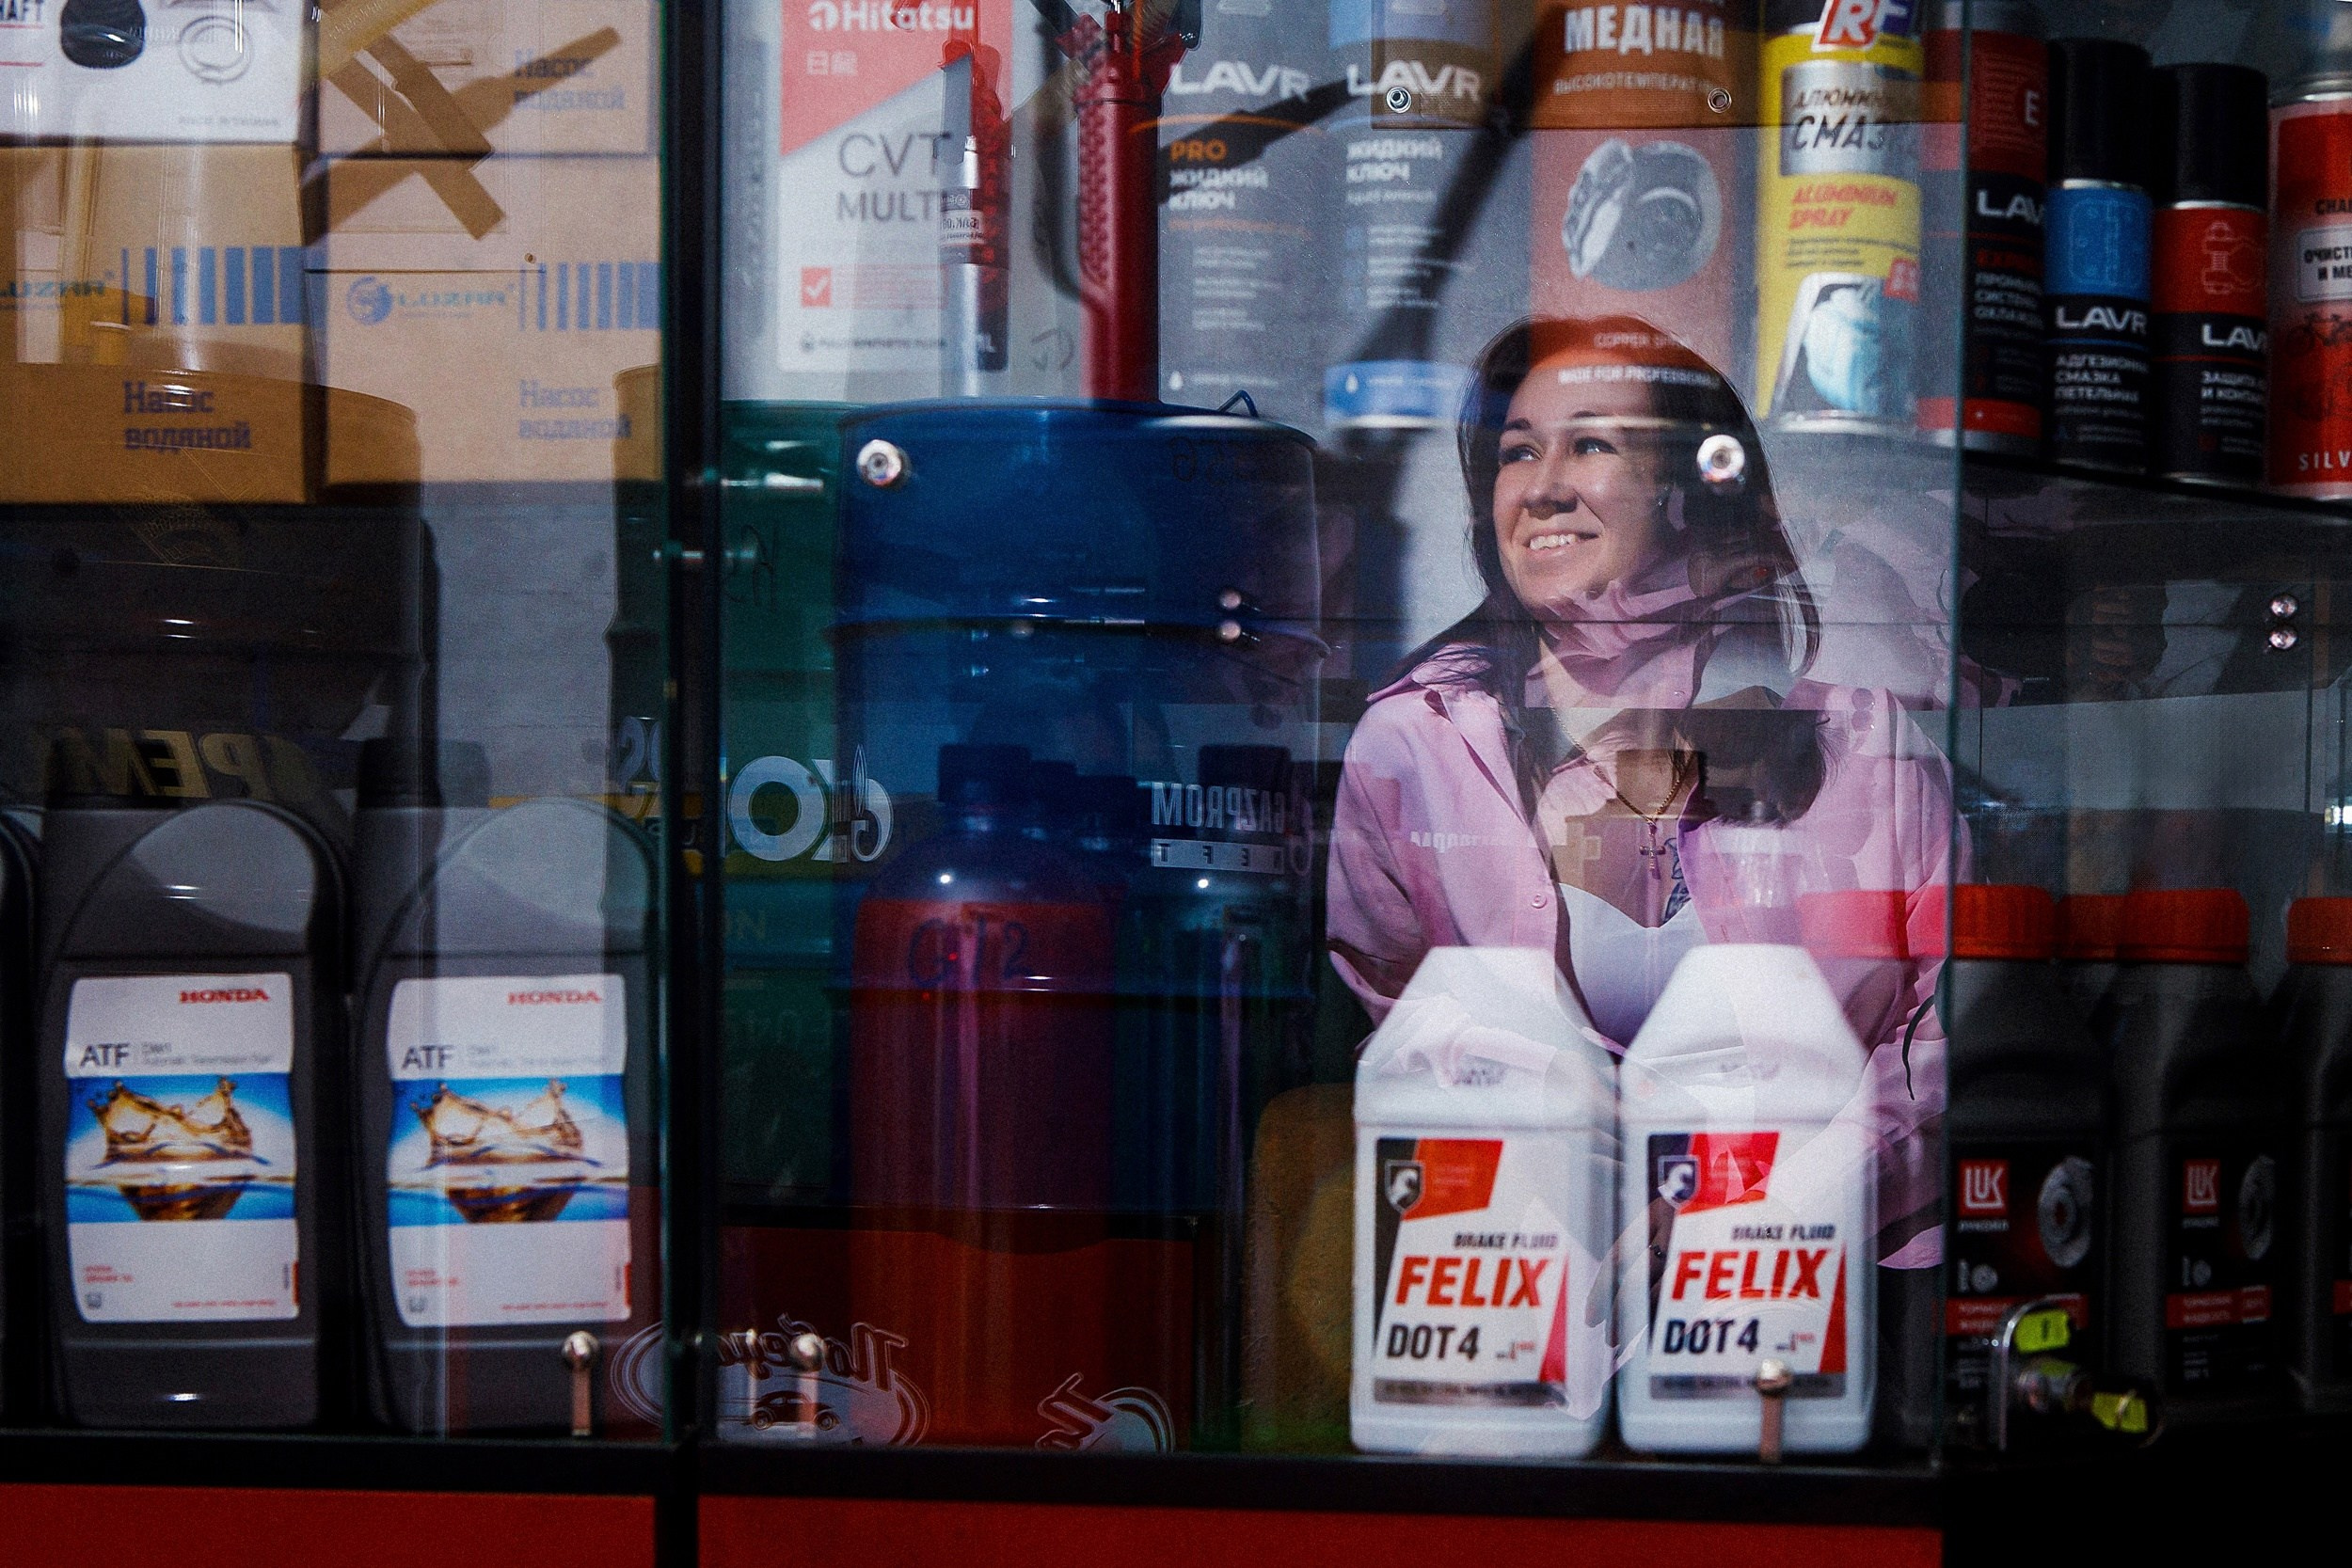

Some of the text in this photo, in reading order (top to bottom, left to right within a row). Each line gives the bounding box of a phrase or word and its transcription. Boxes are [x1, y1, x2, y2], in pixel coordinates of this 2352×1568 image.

[842, 0, 975, 31] Hitatsu
[1564, 6, 1724, 58] МЕДНАЯ
[515, 49, 596, 77] Насос
[1168, 60, 1311, 102] LAVR
[1346, 60, 1482, 102] LAVR
[1792, 114, 1885, 150] СМАЗ
[838, 132, 952, 178] CVT
[1170, 140, 1228, 163] PRO
[1168, 190, 1235, 210] КЛЮЧ
[1977, 189, 2045, 225] LAV
[2055, 306, 2148, 335] LAVR
[123, 380, 215, 415] Насос
[123, 421, 252, 452] водяной
[2298, 451, 2352, 470] SILV
[178, 989, 270, 1005] HONDA
[507, 990, 602, 1006] HONDA
[80, 1043, 131, 1069] ATF
[402, 1045, 455, 1070] ATF
[1511, 1232, 1559, 1249] FLUID
[1789, 1224, 1836, 1242] FLUID
[1394, 1256, 1552, 1308] FELIX
[1671, 1248, 1831, 1301] FELIX
